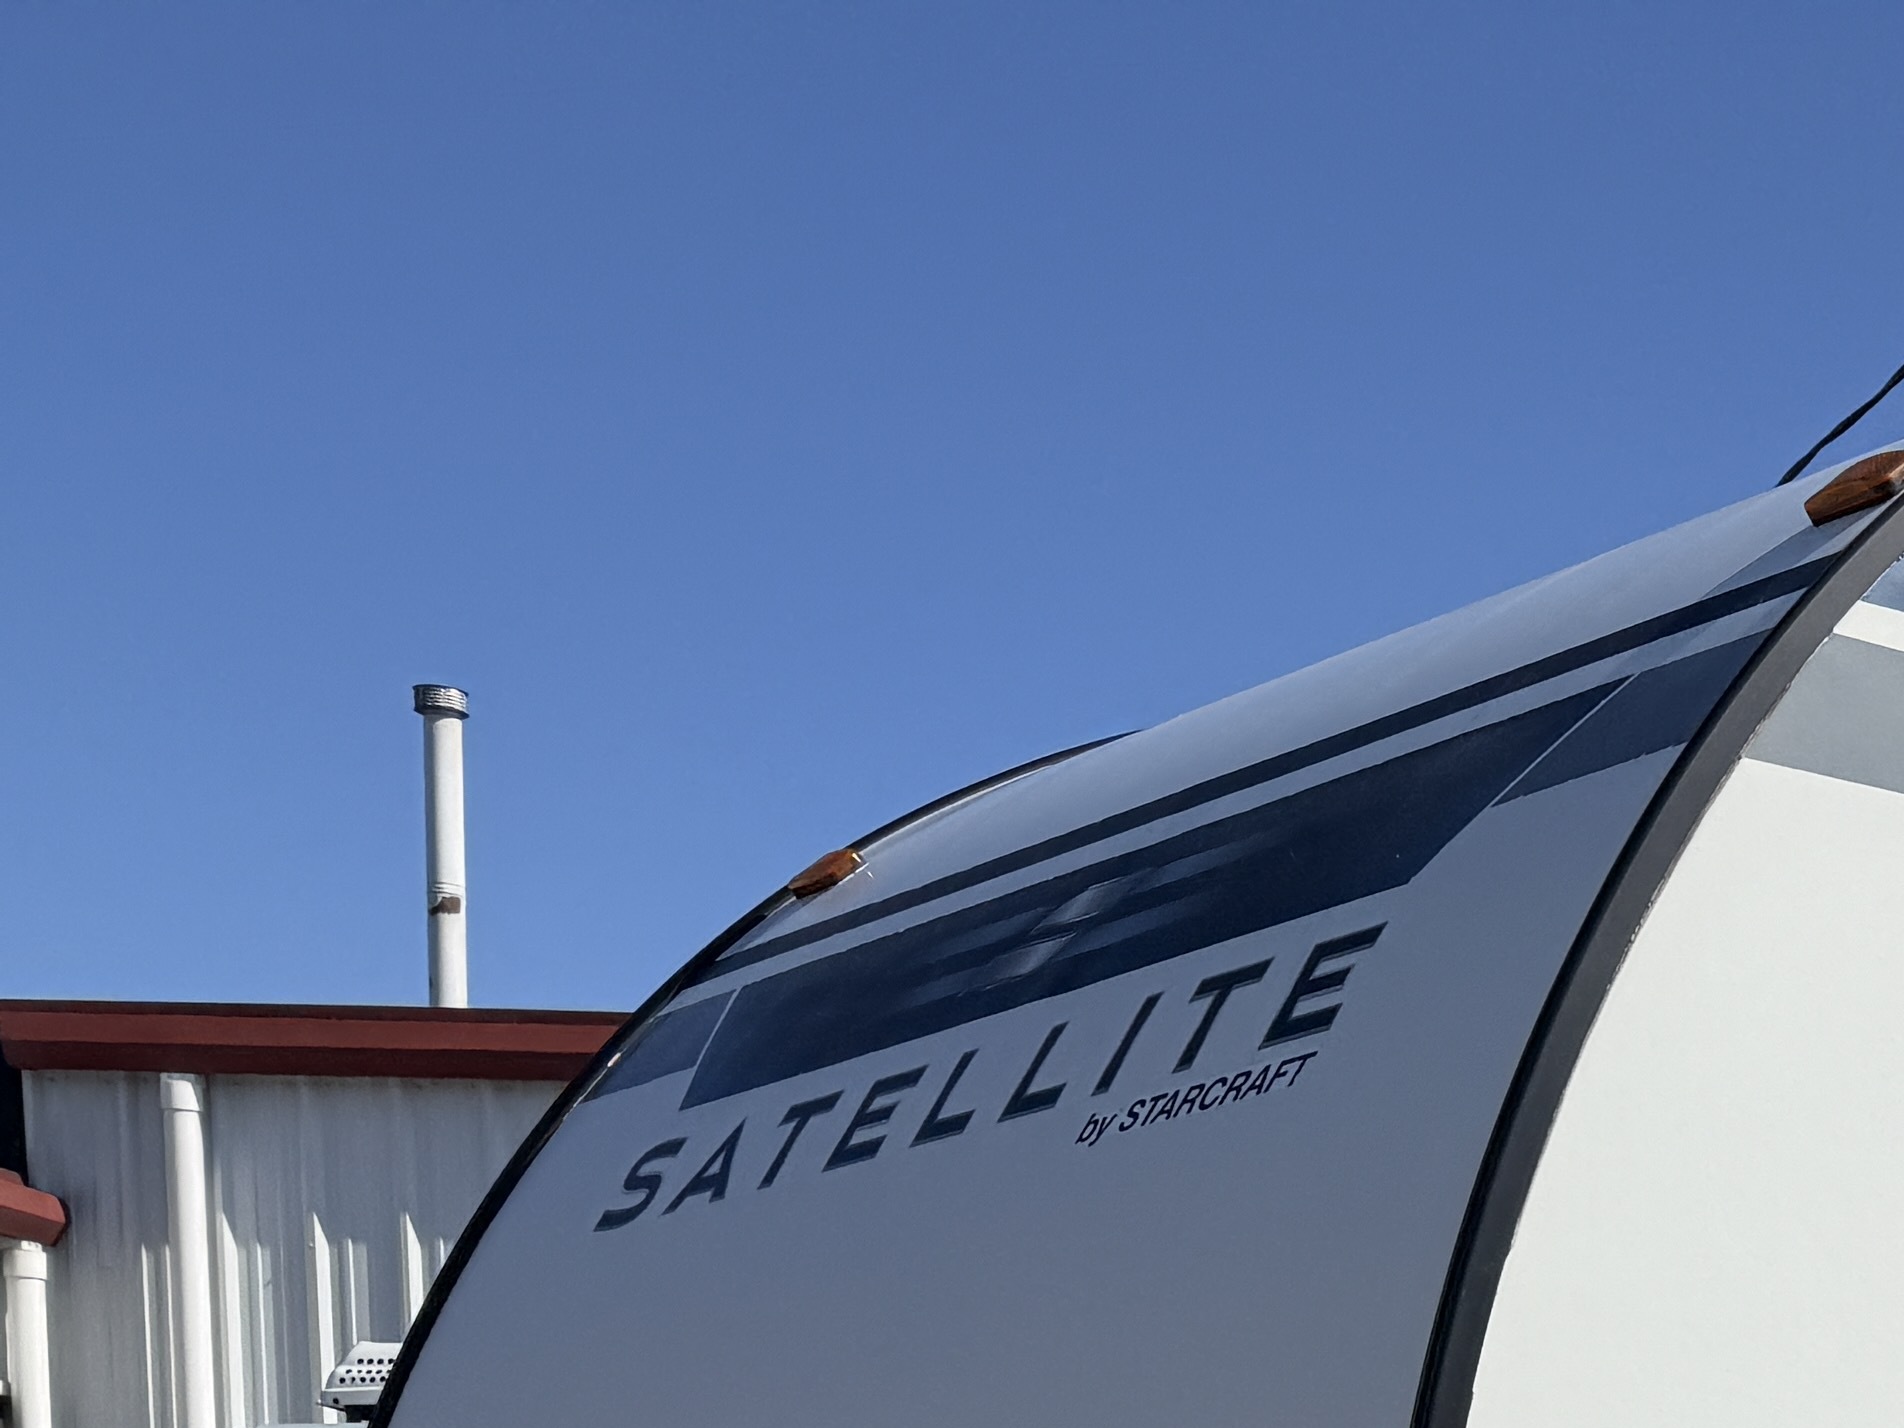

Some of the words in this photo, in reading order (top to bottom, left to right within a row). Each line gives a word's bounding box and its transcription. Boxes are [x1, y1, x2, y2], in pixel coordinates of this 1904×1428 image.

[593, 921, 1389, 1233] SATELLITE
[1075, 1112, 1118, 1148] by
[1118, 1051, 1319, 1133] STARCRAFT
